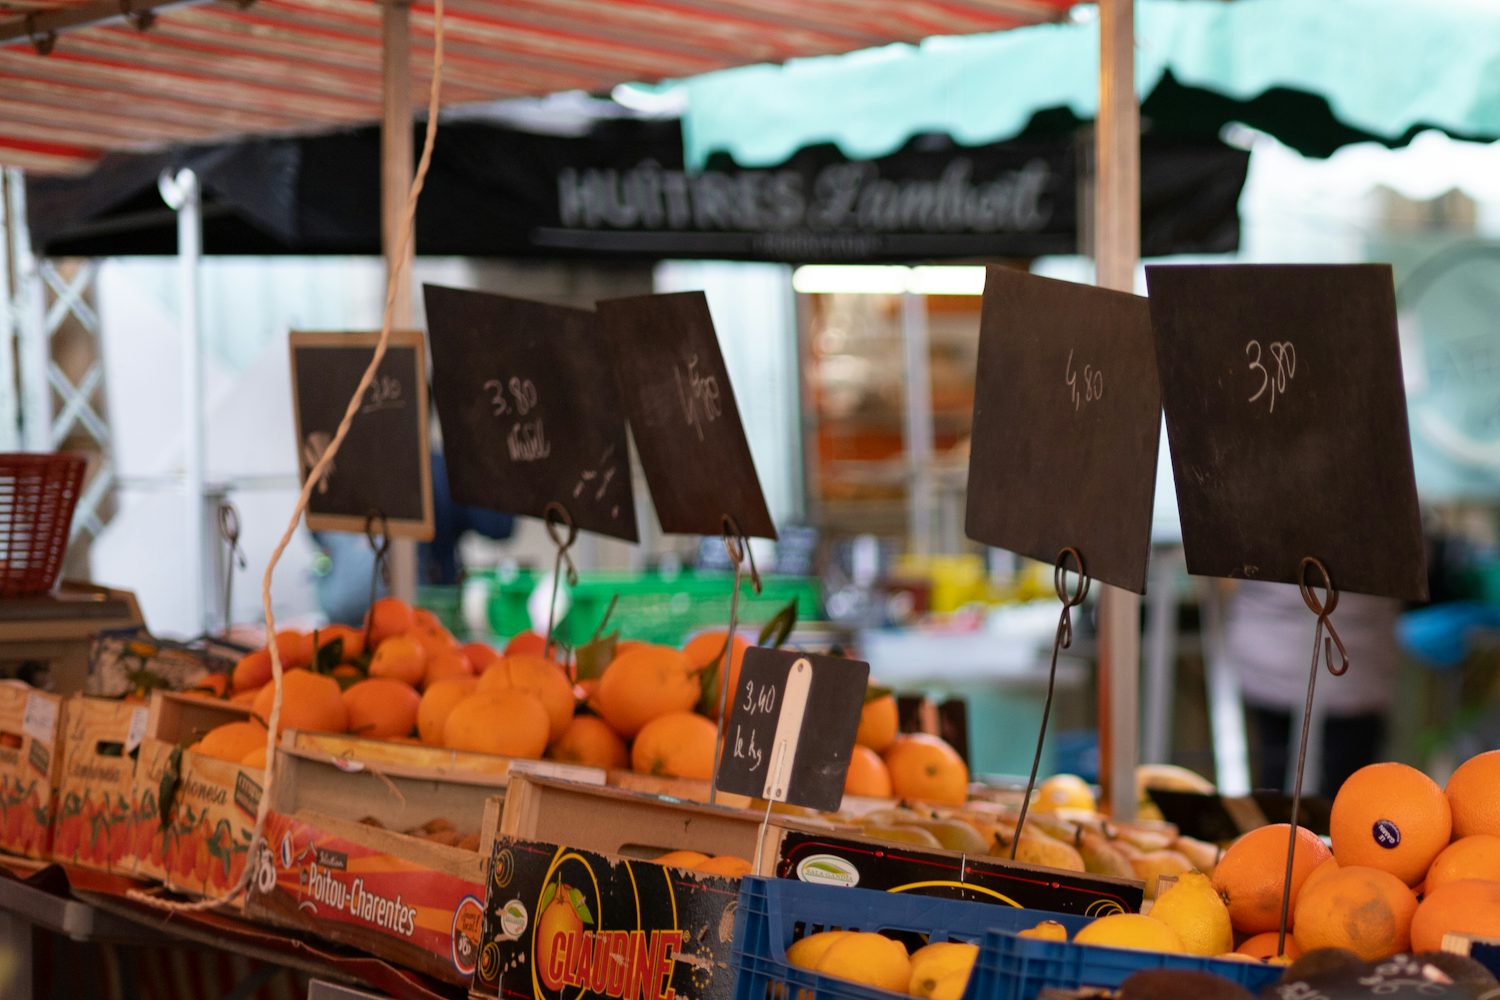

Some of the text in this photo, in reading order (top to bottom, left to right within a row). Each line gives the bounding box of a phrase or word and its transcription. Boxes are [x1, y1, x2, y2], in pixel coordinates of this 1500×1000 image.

[1066, 348, 1103, 411] 4,80
[1246, 340, 1296, 413] 3,80
[743, 680, 776, 715] 3,40
[748, 729, 762, 772] kg
[307, 861, 417, 937] Poitou-Charentes
